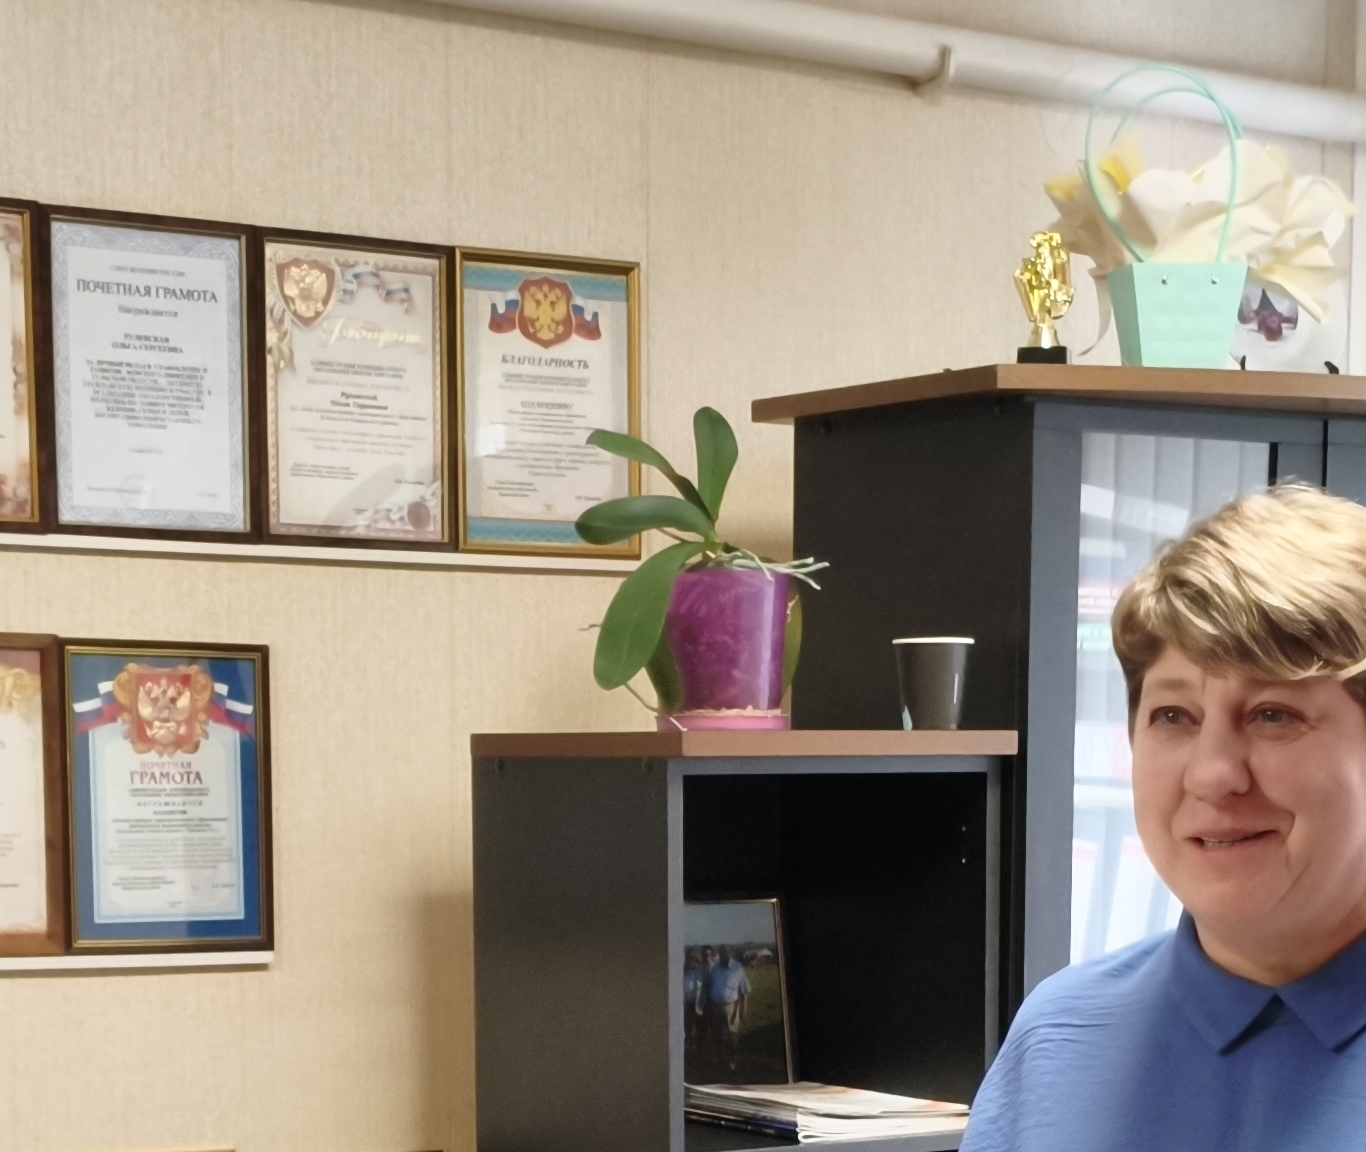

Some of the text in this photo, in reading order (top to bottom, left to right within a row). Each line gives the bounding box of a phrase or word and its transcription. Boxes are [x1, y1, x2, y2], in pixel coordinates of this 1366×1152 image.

[76, 278, 219, 304] ПОЧЕТНАЯ ГРАМОТА
[129, 770, 203, 786] ГРАМОТА
